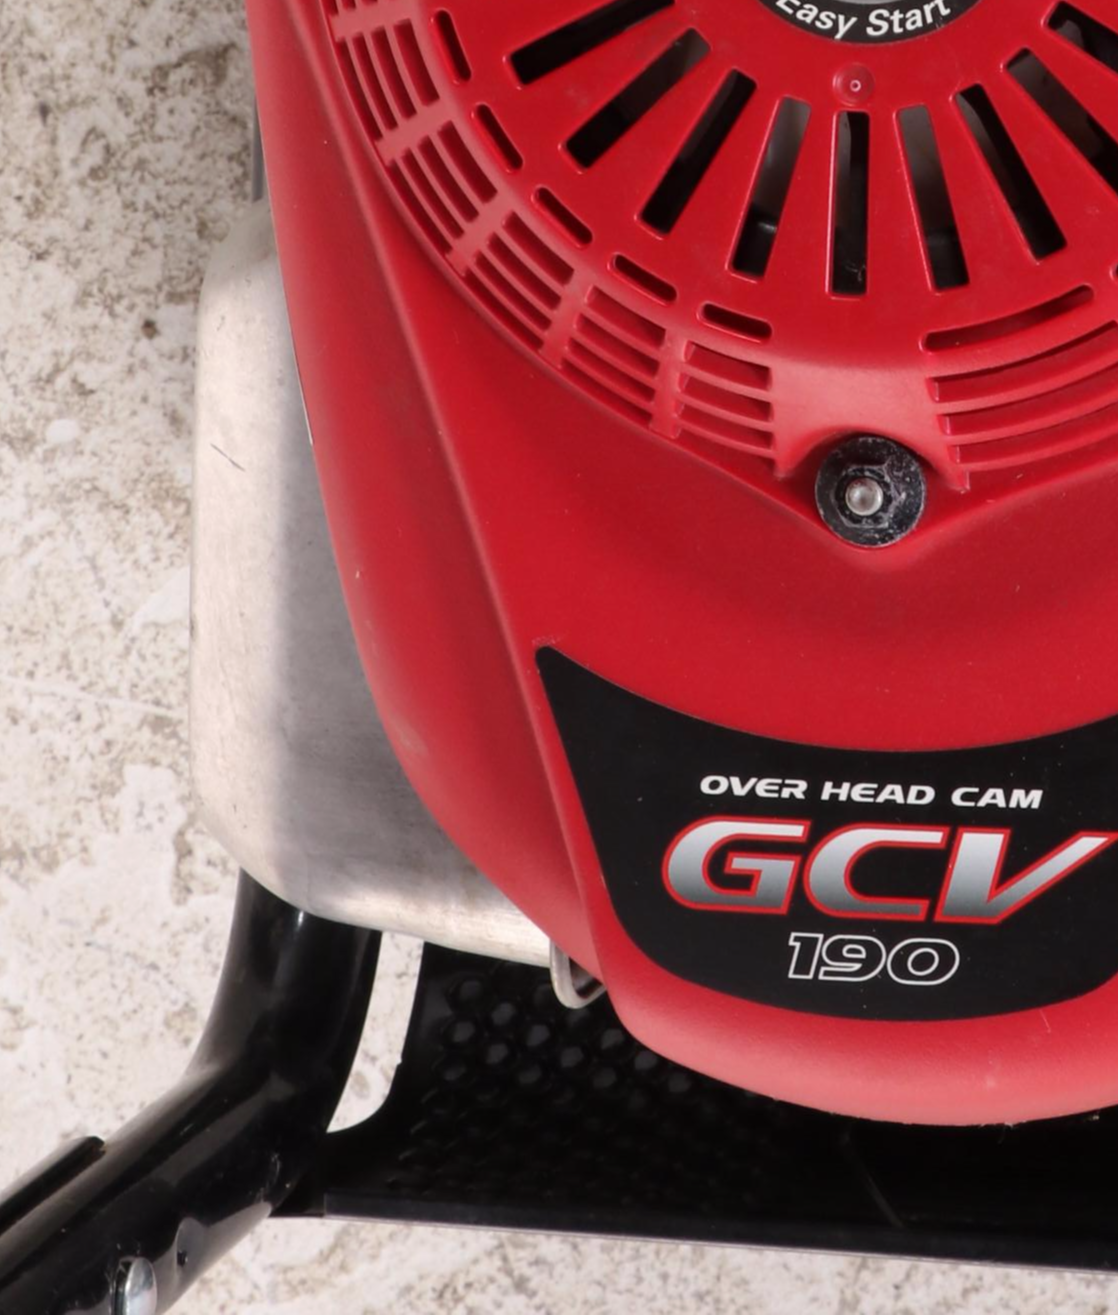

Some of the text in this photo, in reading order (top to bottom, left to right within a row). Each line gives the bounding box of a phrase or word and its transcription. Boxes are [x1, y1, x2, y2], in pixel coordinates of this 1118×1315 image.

[700, 775, 1044, 809] OVER HEAD CAM
[787, 932, 960, 986] 190
